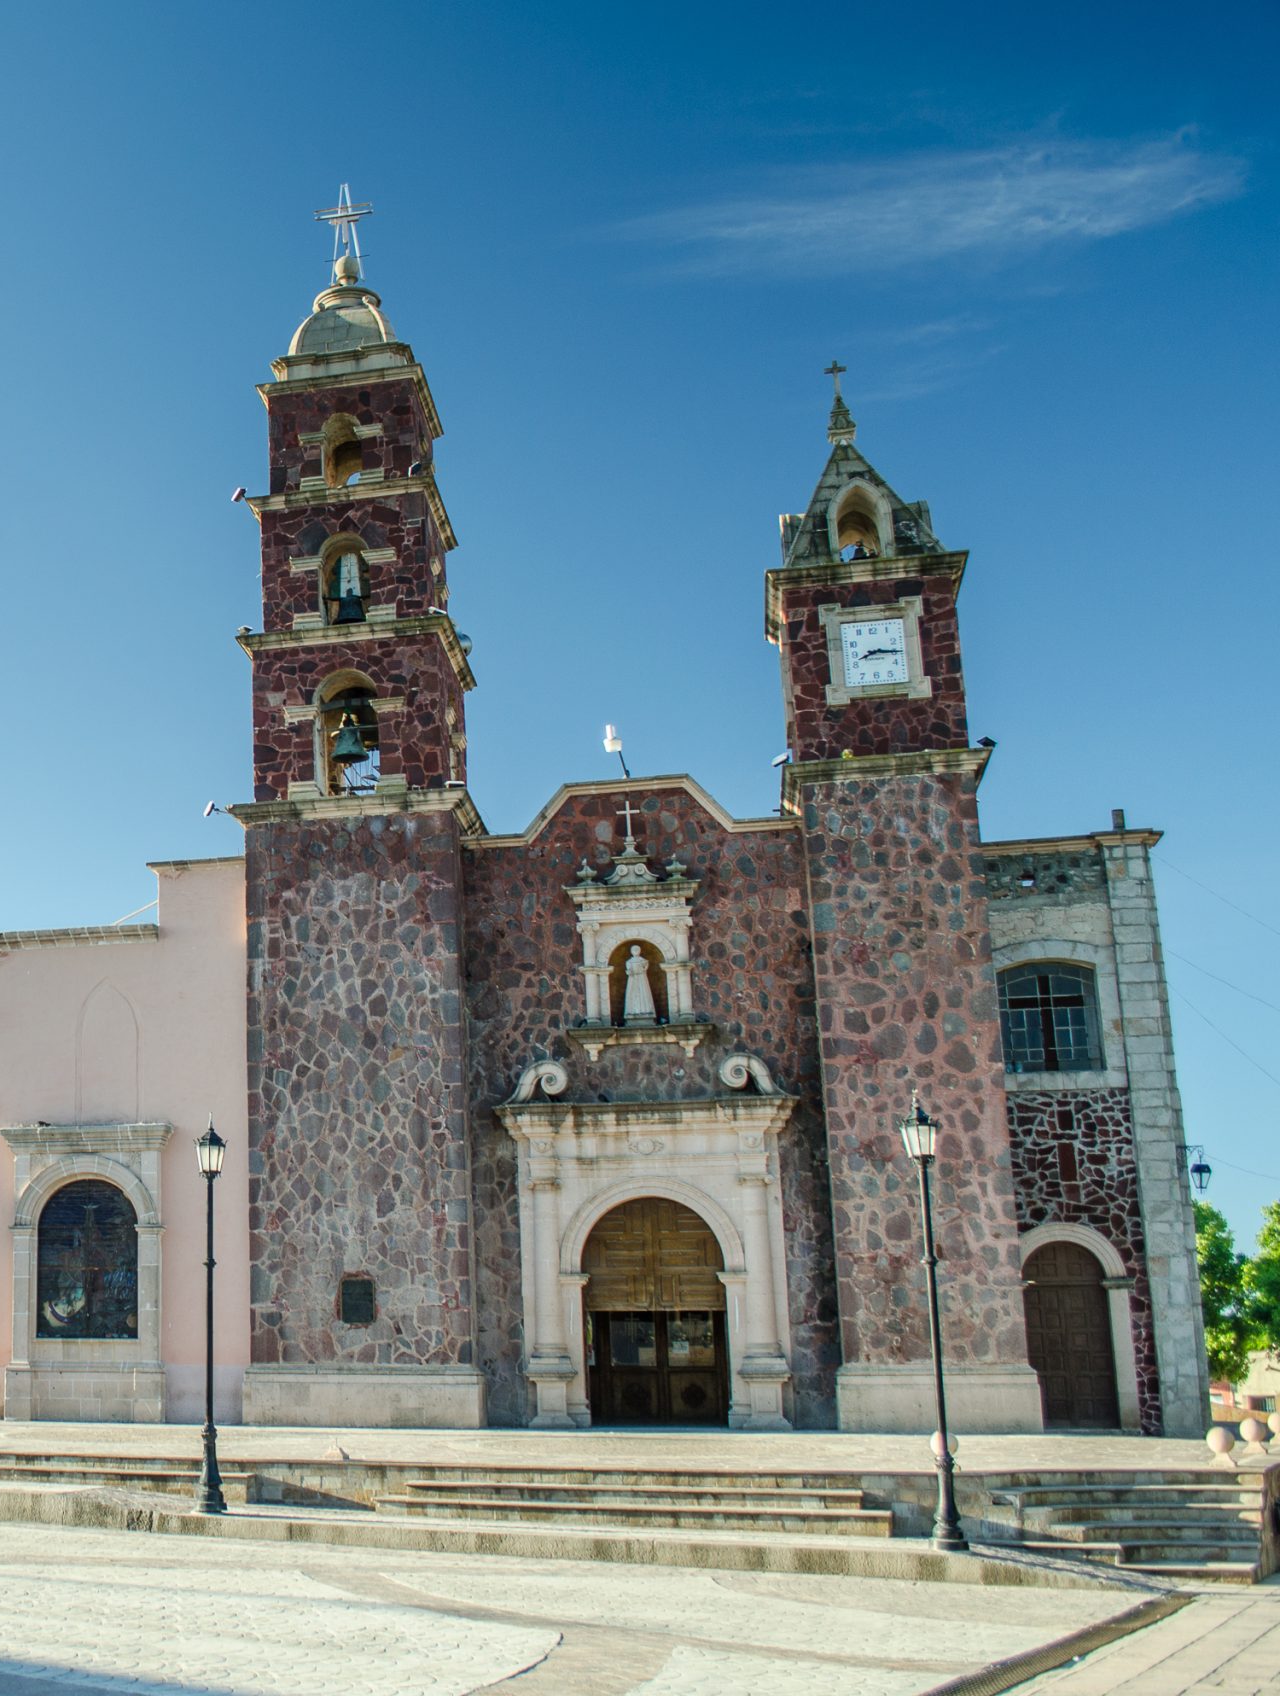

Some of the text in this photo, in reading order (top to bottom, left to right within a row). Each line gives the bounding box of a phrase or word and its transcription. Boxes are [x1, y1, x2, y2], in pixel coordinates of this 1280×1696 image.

[855, 628, 862, 636] 11
[868, 627, 877, 635] 12
[849, 640, 858, 648] 10
[890, 637, 897, 645] 2
[851, 651, 858, 659] 9
[852, 661, 859, 669] 8
[892, 658, 898, 666] 4
[859, 672, 866, 680] 7
[873, 671, 880, 679] 6
[887, 670, 894, 678] 5
